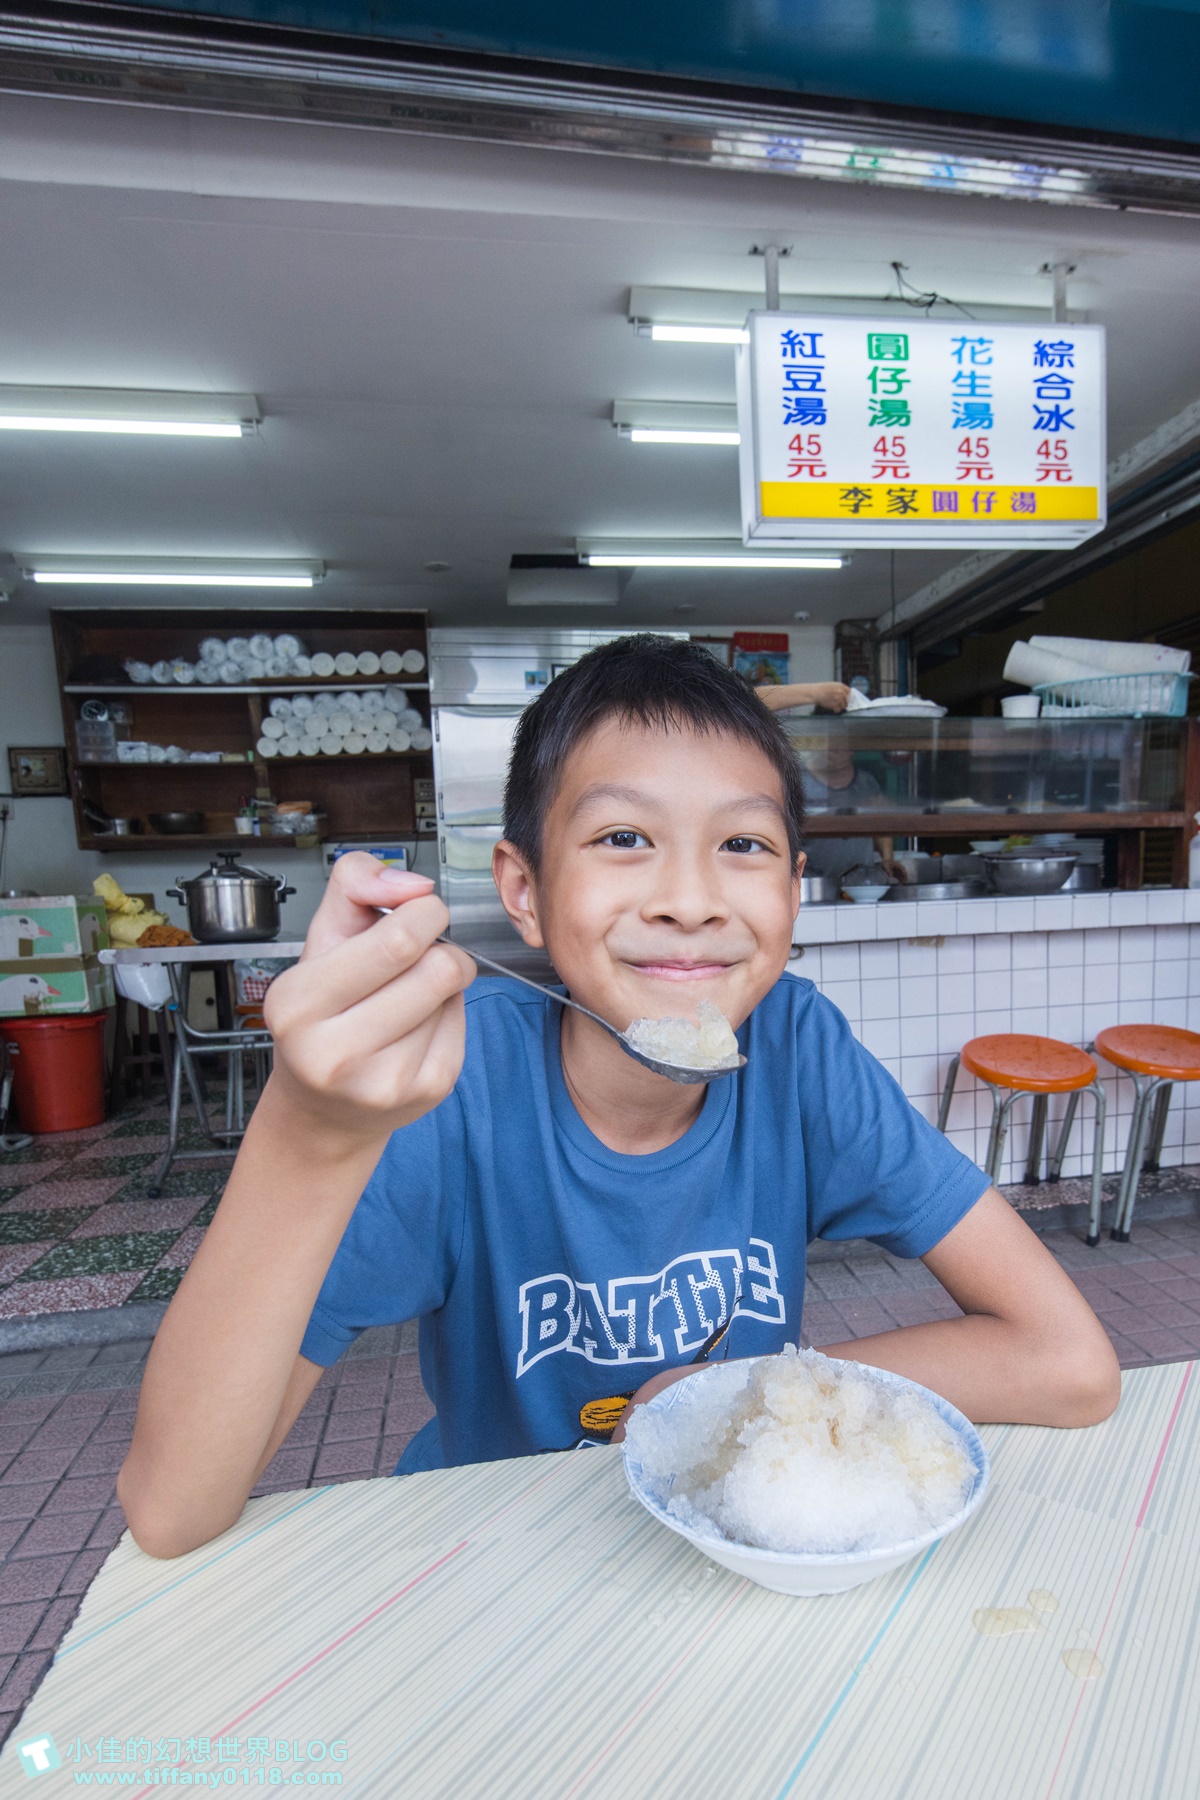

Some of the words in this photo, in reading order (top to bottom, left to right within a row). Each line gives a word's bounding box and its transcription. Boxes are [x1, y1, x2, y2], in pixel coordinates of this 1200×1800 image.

[781, 330, 827, 426] 紅豆湯
[867, 333, 911, 428] 圓仔湯
[951, 336, 995, 431] 花生湯
[1033, 340, 1076, 432] 綜合冰
